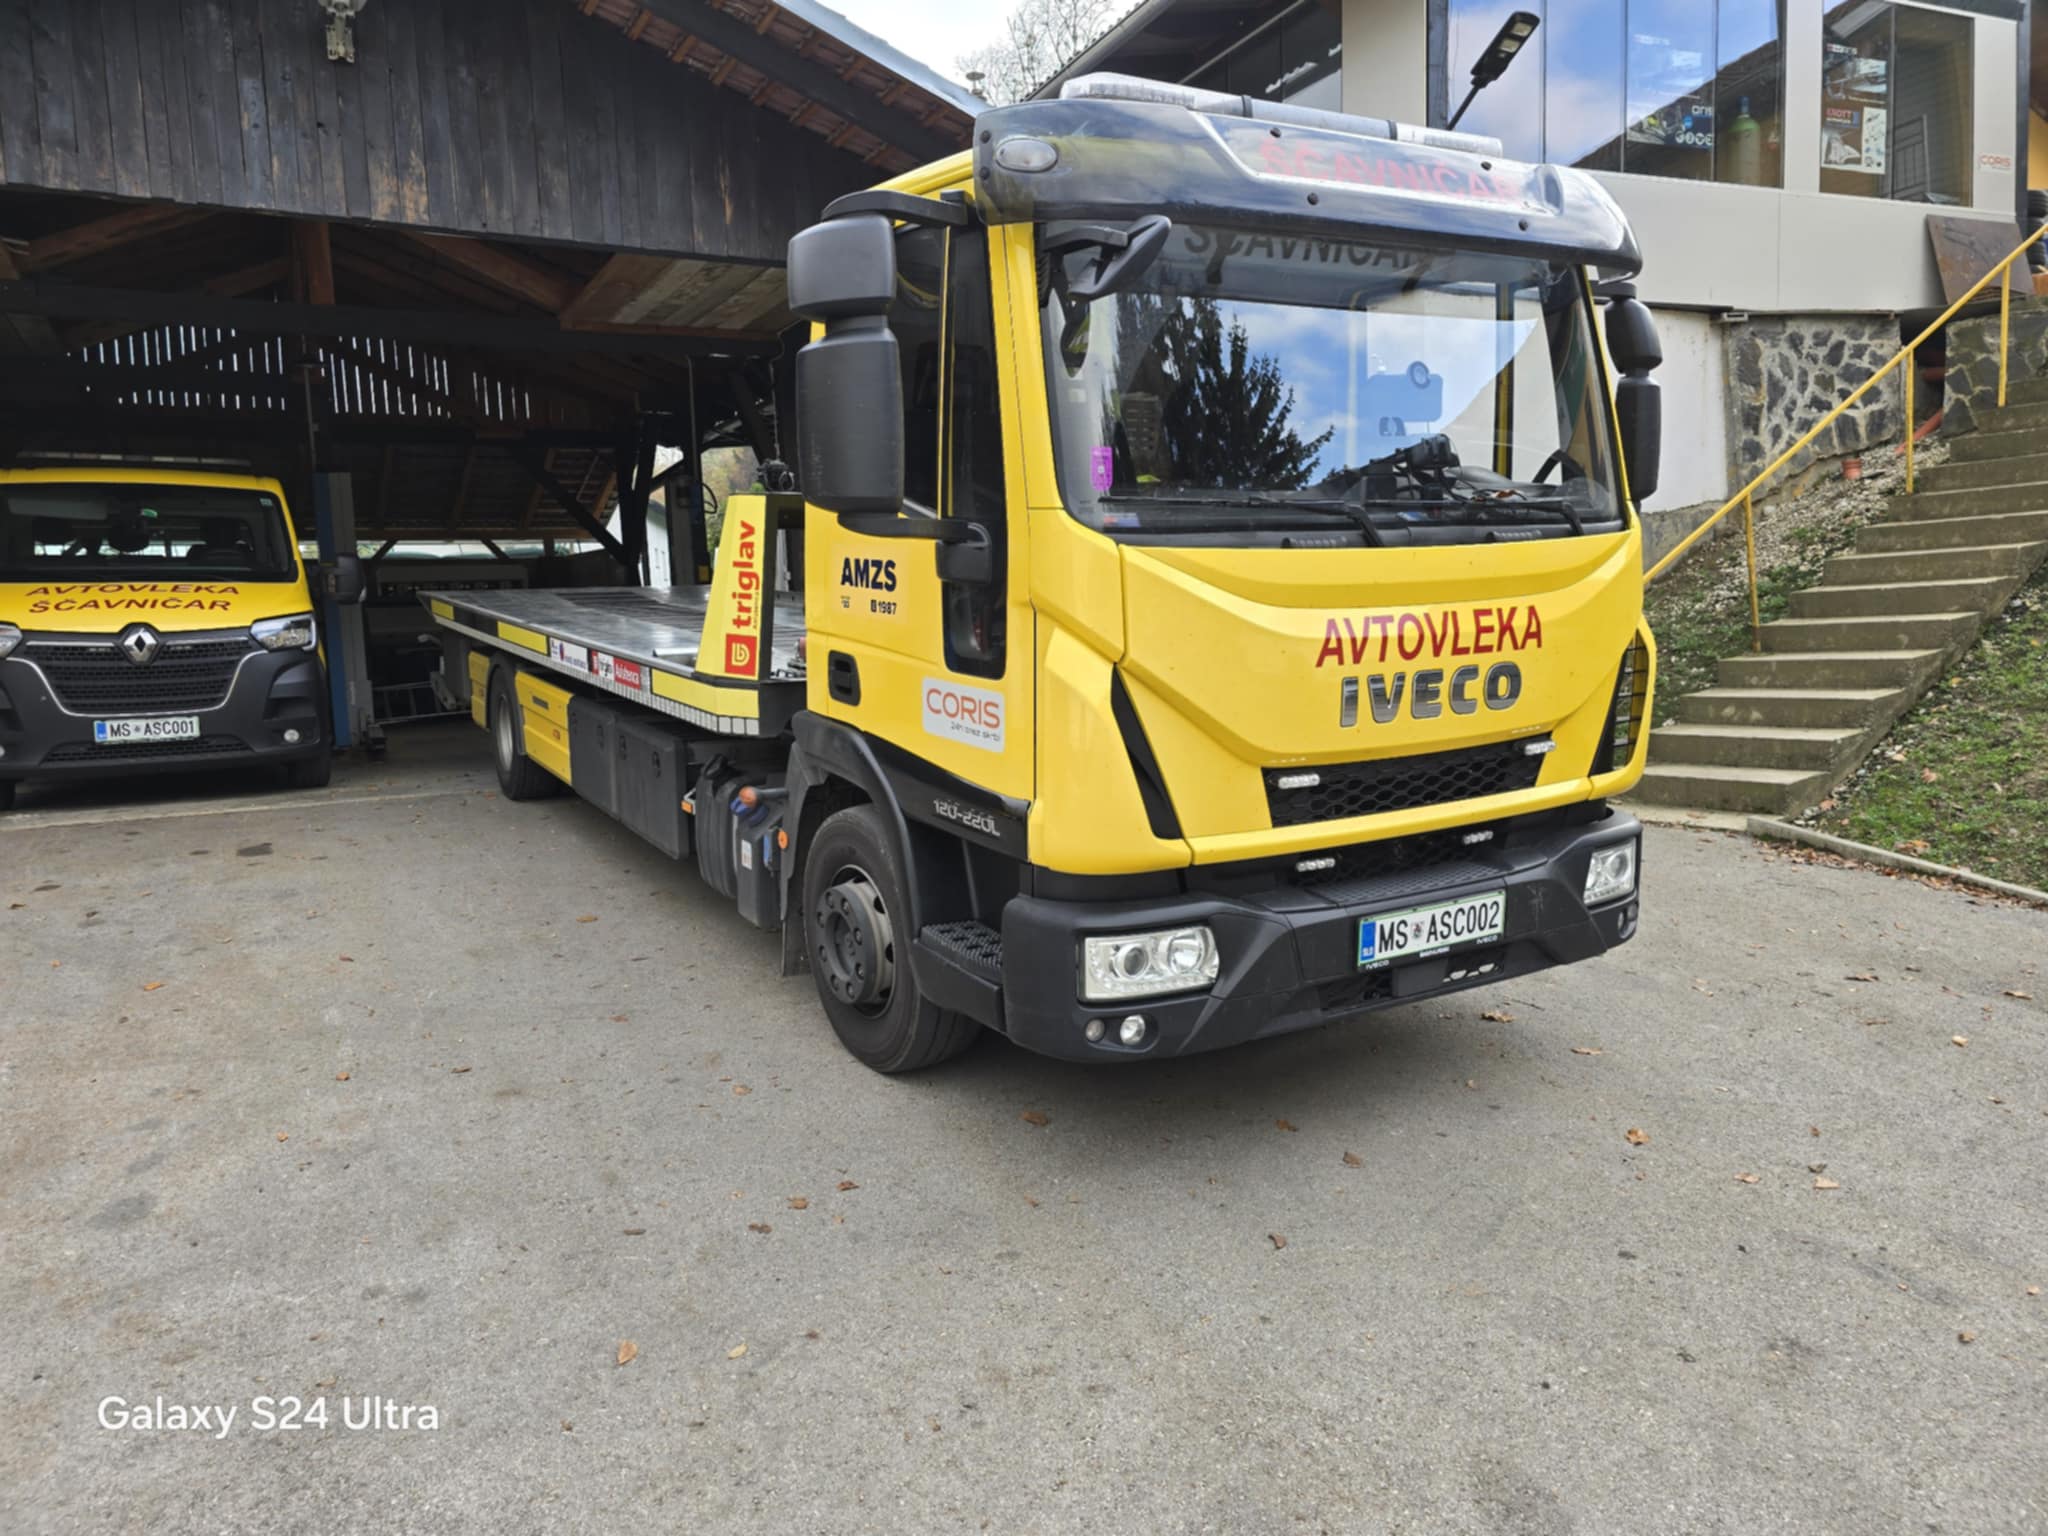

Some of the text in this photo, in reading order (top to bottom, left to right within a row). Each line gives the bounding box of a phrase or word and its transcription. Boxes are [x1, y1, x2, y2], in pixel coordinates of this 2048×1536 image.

[26, 583, 239, 596] AVTOVLEKA
[732, 520, 760, 628] triglav
[840, 556, 897, 592] AMZS
[1315, 604, 1543, 668] AVTOVLEKA
[926, 688, 1001, 730] CORIS
[1339, 661, 1523, 728] IVECO
[110, 721, 194, 737] MS ASC001
[1378, 900, 1500, 953] MS ASC002
